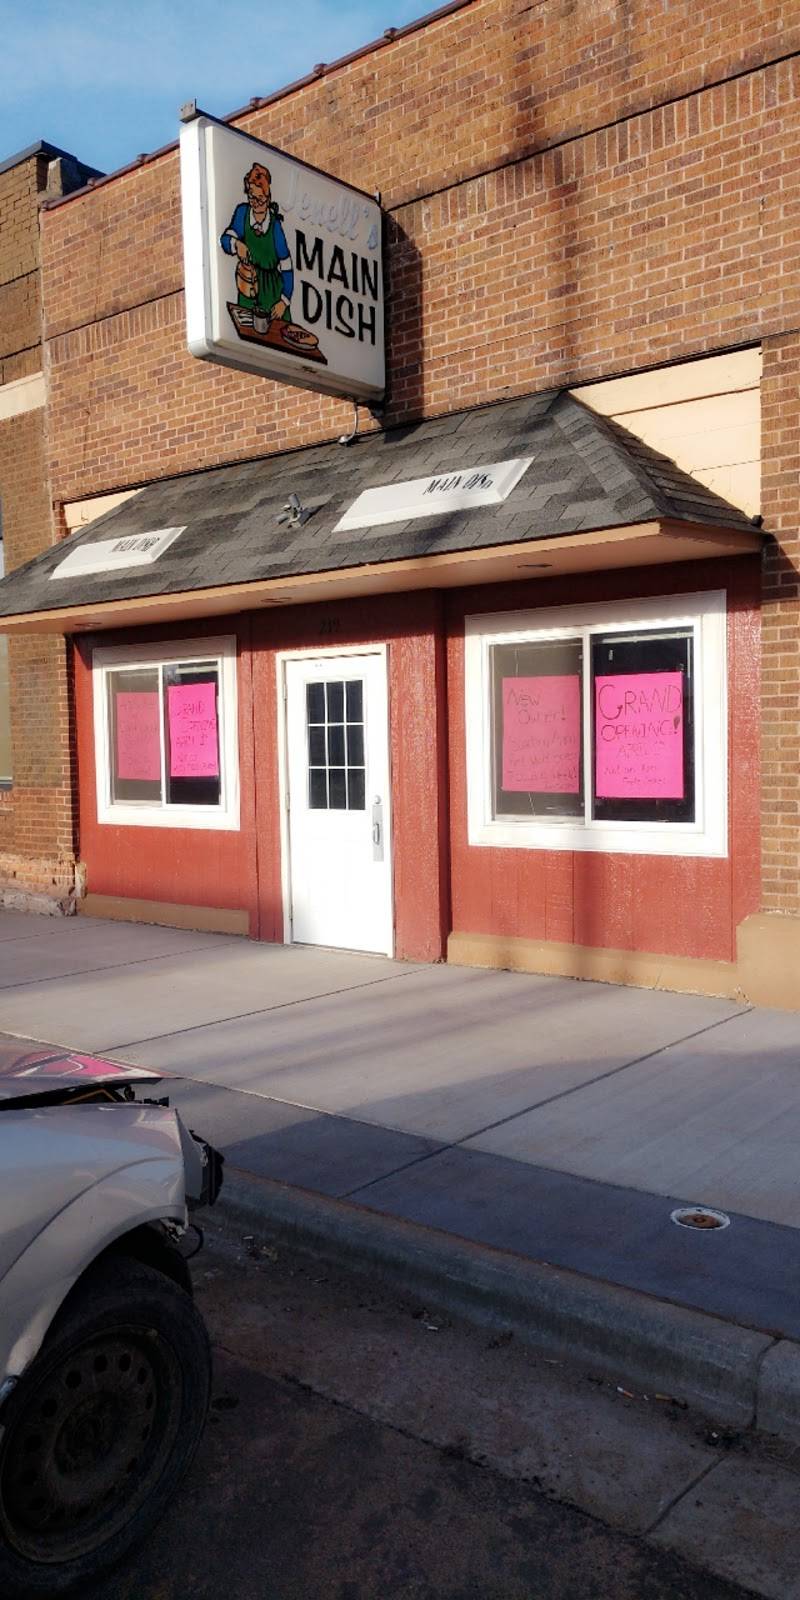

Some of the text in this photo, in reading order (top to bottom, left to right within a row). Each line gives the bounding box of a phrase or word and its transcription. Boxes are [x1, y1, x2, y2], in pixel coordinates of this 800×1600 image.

[295, 229, 379, 301] MAIN
[300, 280, 376, 346] DISH
[423, 474, 462, 495] MAIN
[598, 683, 682, 721] GRAND
